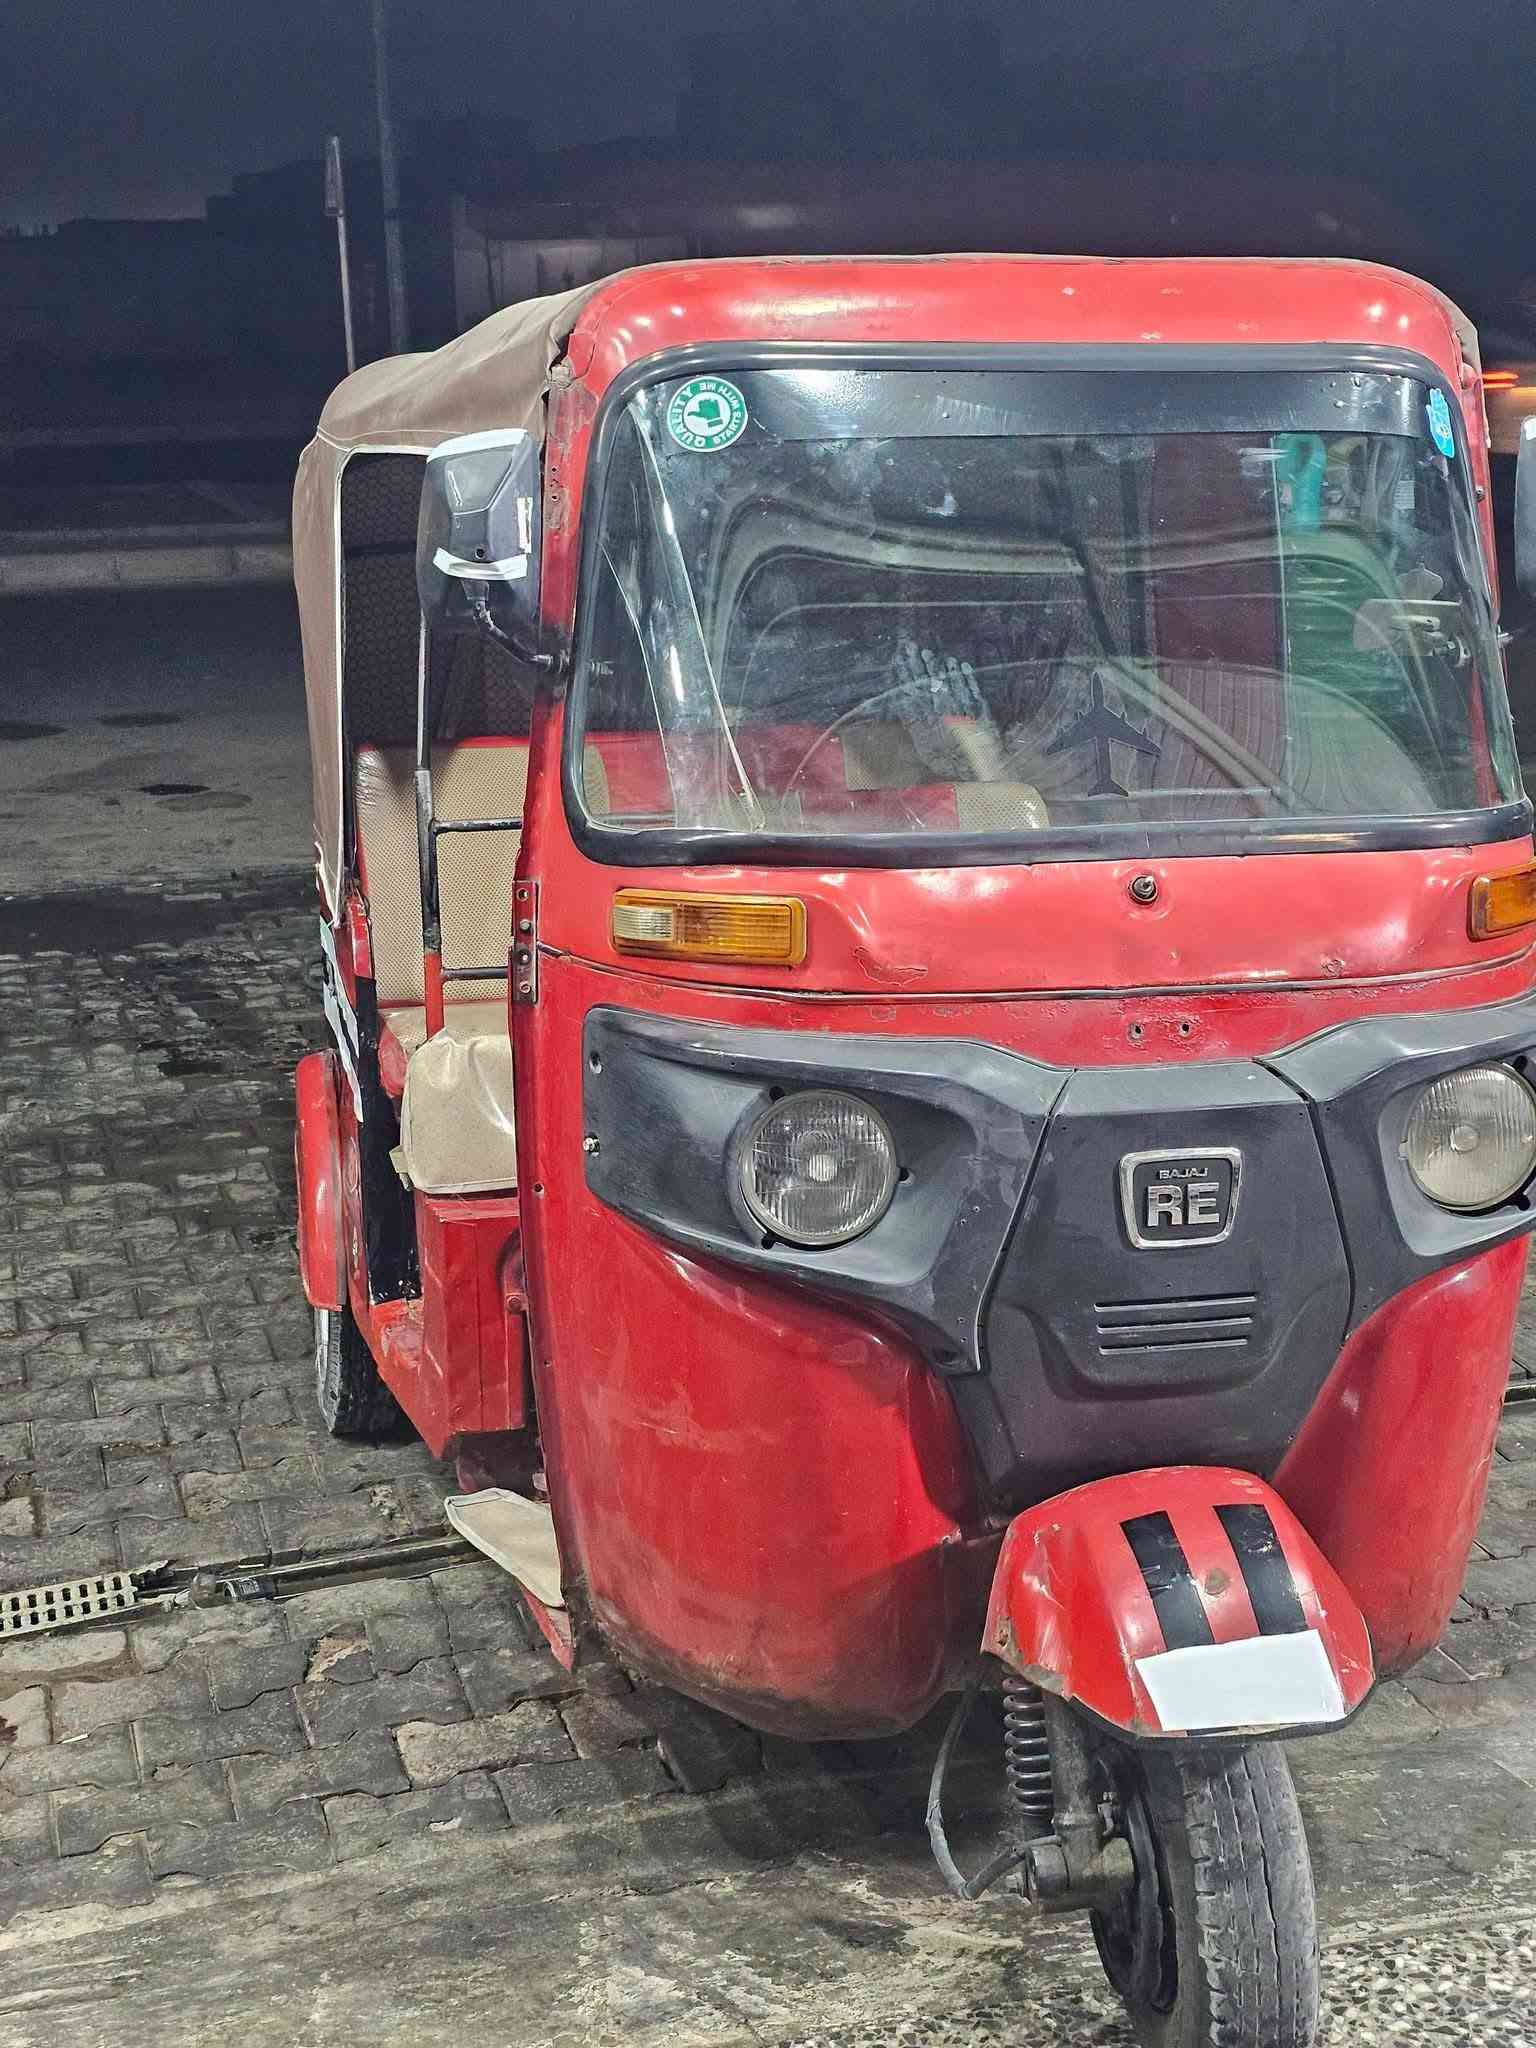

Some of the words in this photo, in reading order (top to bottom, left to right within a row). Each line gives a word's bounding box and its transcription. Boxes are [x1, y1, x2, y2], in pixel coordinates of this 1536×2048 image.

[699, 382, 717, 391] ME
[718, 386, 741, 409] WITH
[671, 386, 706, 448] QUALITY
[712, 411, 742, 445] STARTS
[1159, 1167, 1209, 1180] BAJAJ
[1147, 1182, 1220, 1227] RE
